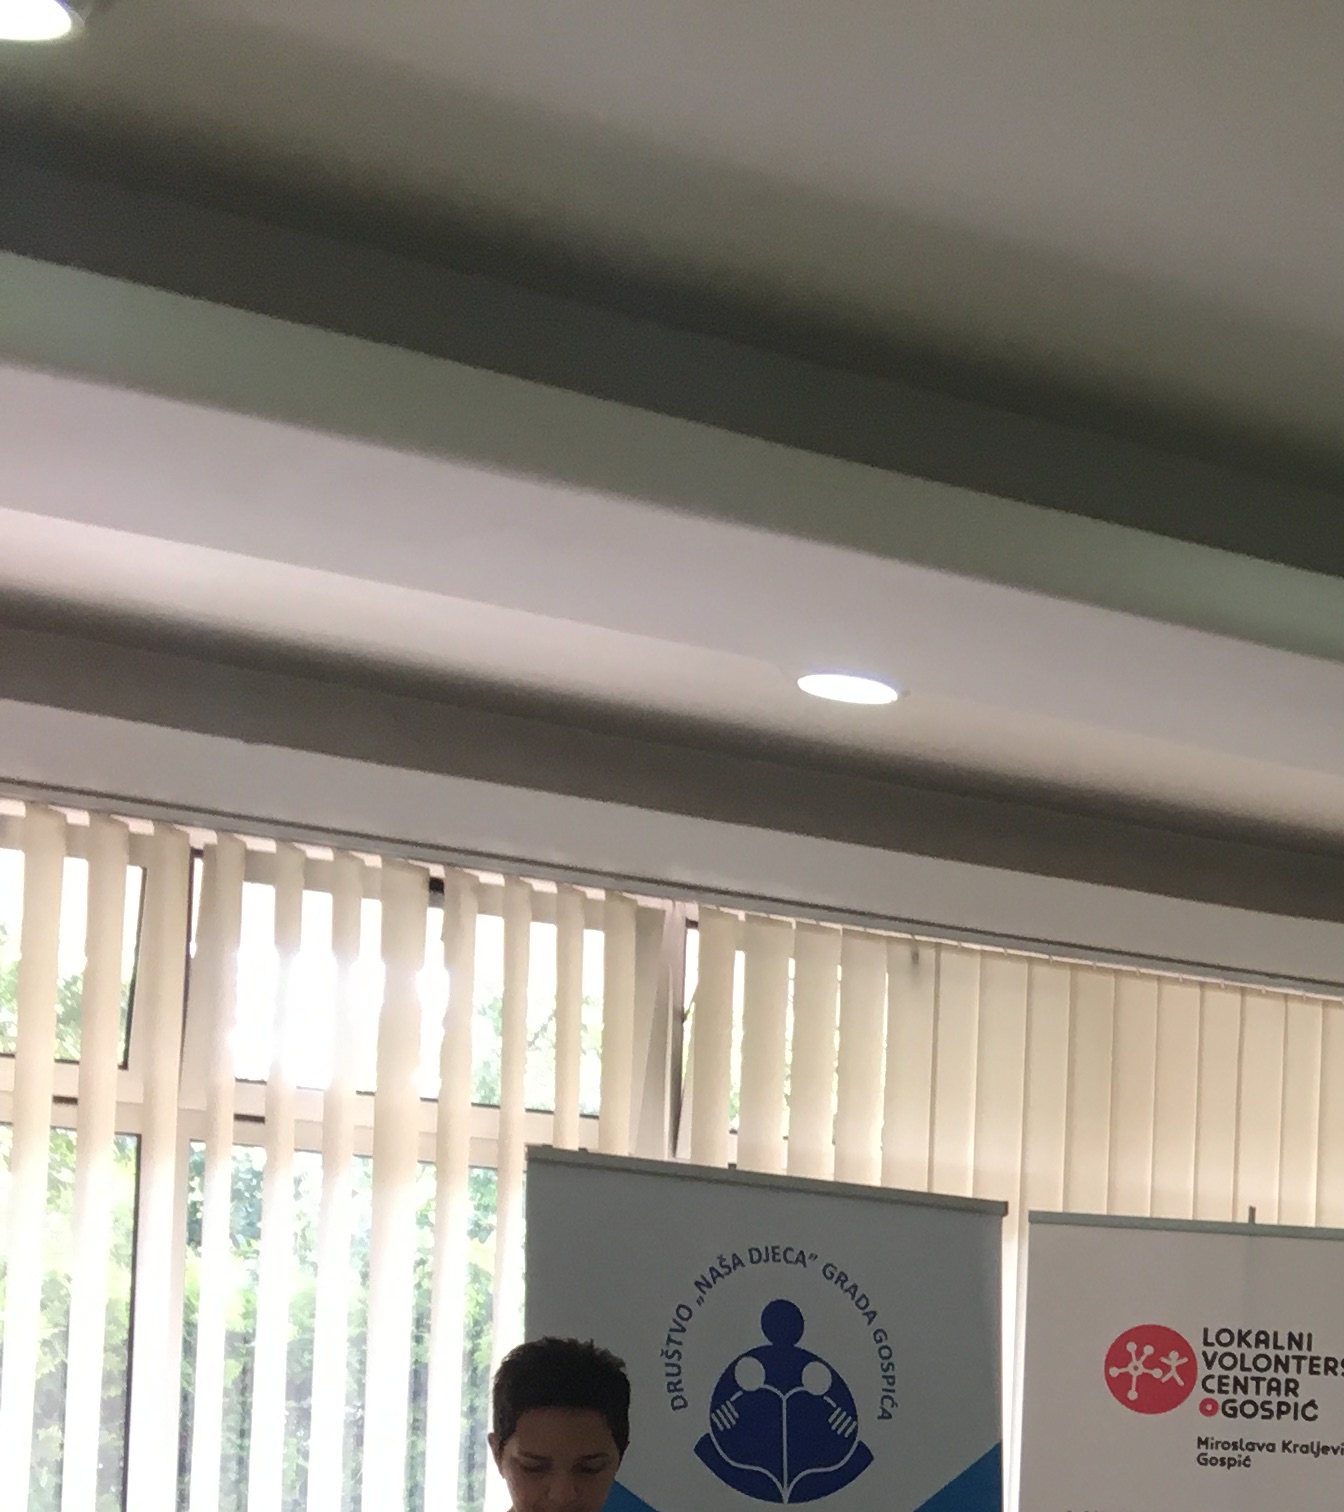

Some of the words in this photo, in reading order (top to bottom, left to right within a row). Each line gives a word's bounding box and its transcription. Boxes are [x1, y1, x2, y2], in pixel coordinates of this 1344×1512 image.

[660, 1303, 694, 1412] DRUŠTVO
[822, 1263, 878, 1326] GRADA
[873, 1328, 899, 1421] GOSPIĆA
[1202, 1327, 1313, 1352] LOKALNI
[1201, 1374, 1300, 1398] CENTAR
[1197, 1436, 1276, 1453] Miroslava
[1196, 1452, 1251, 1470] Gospić
